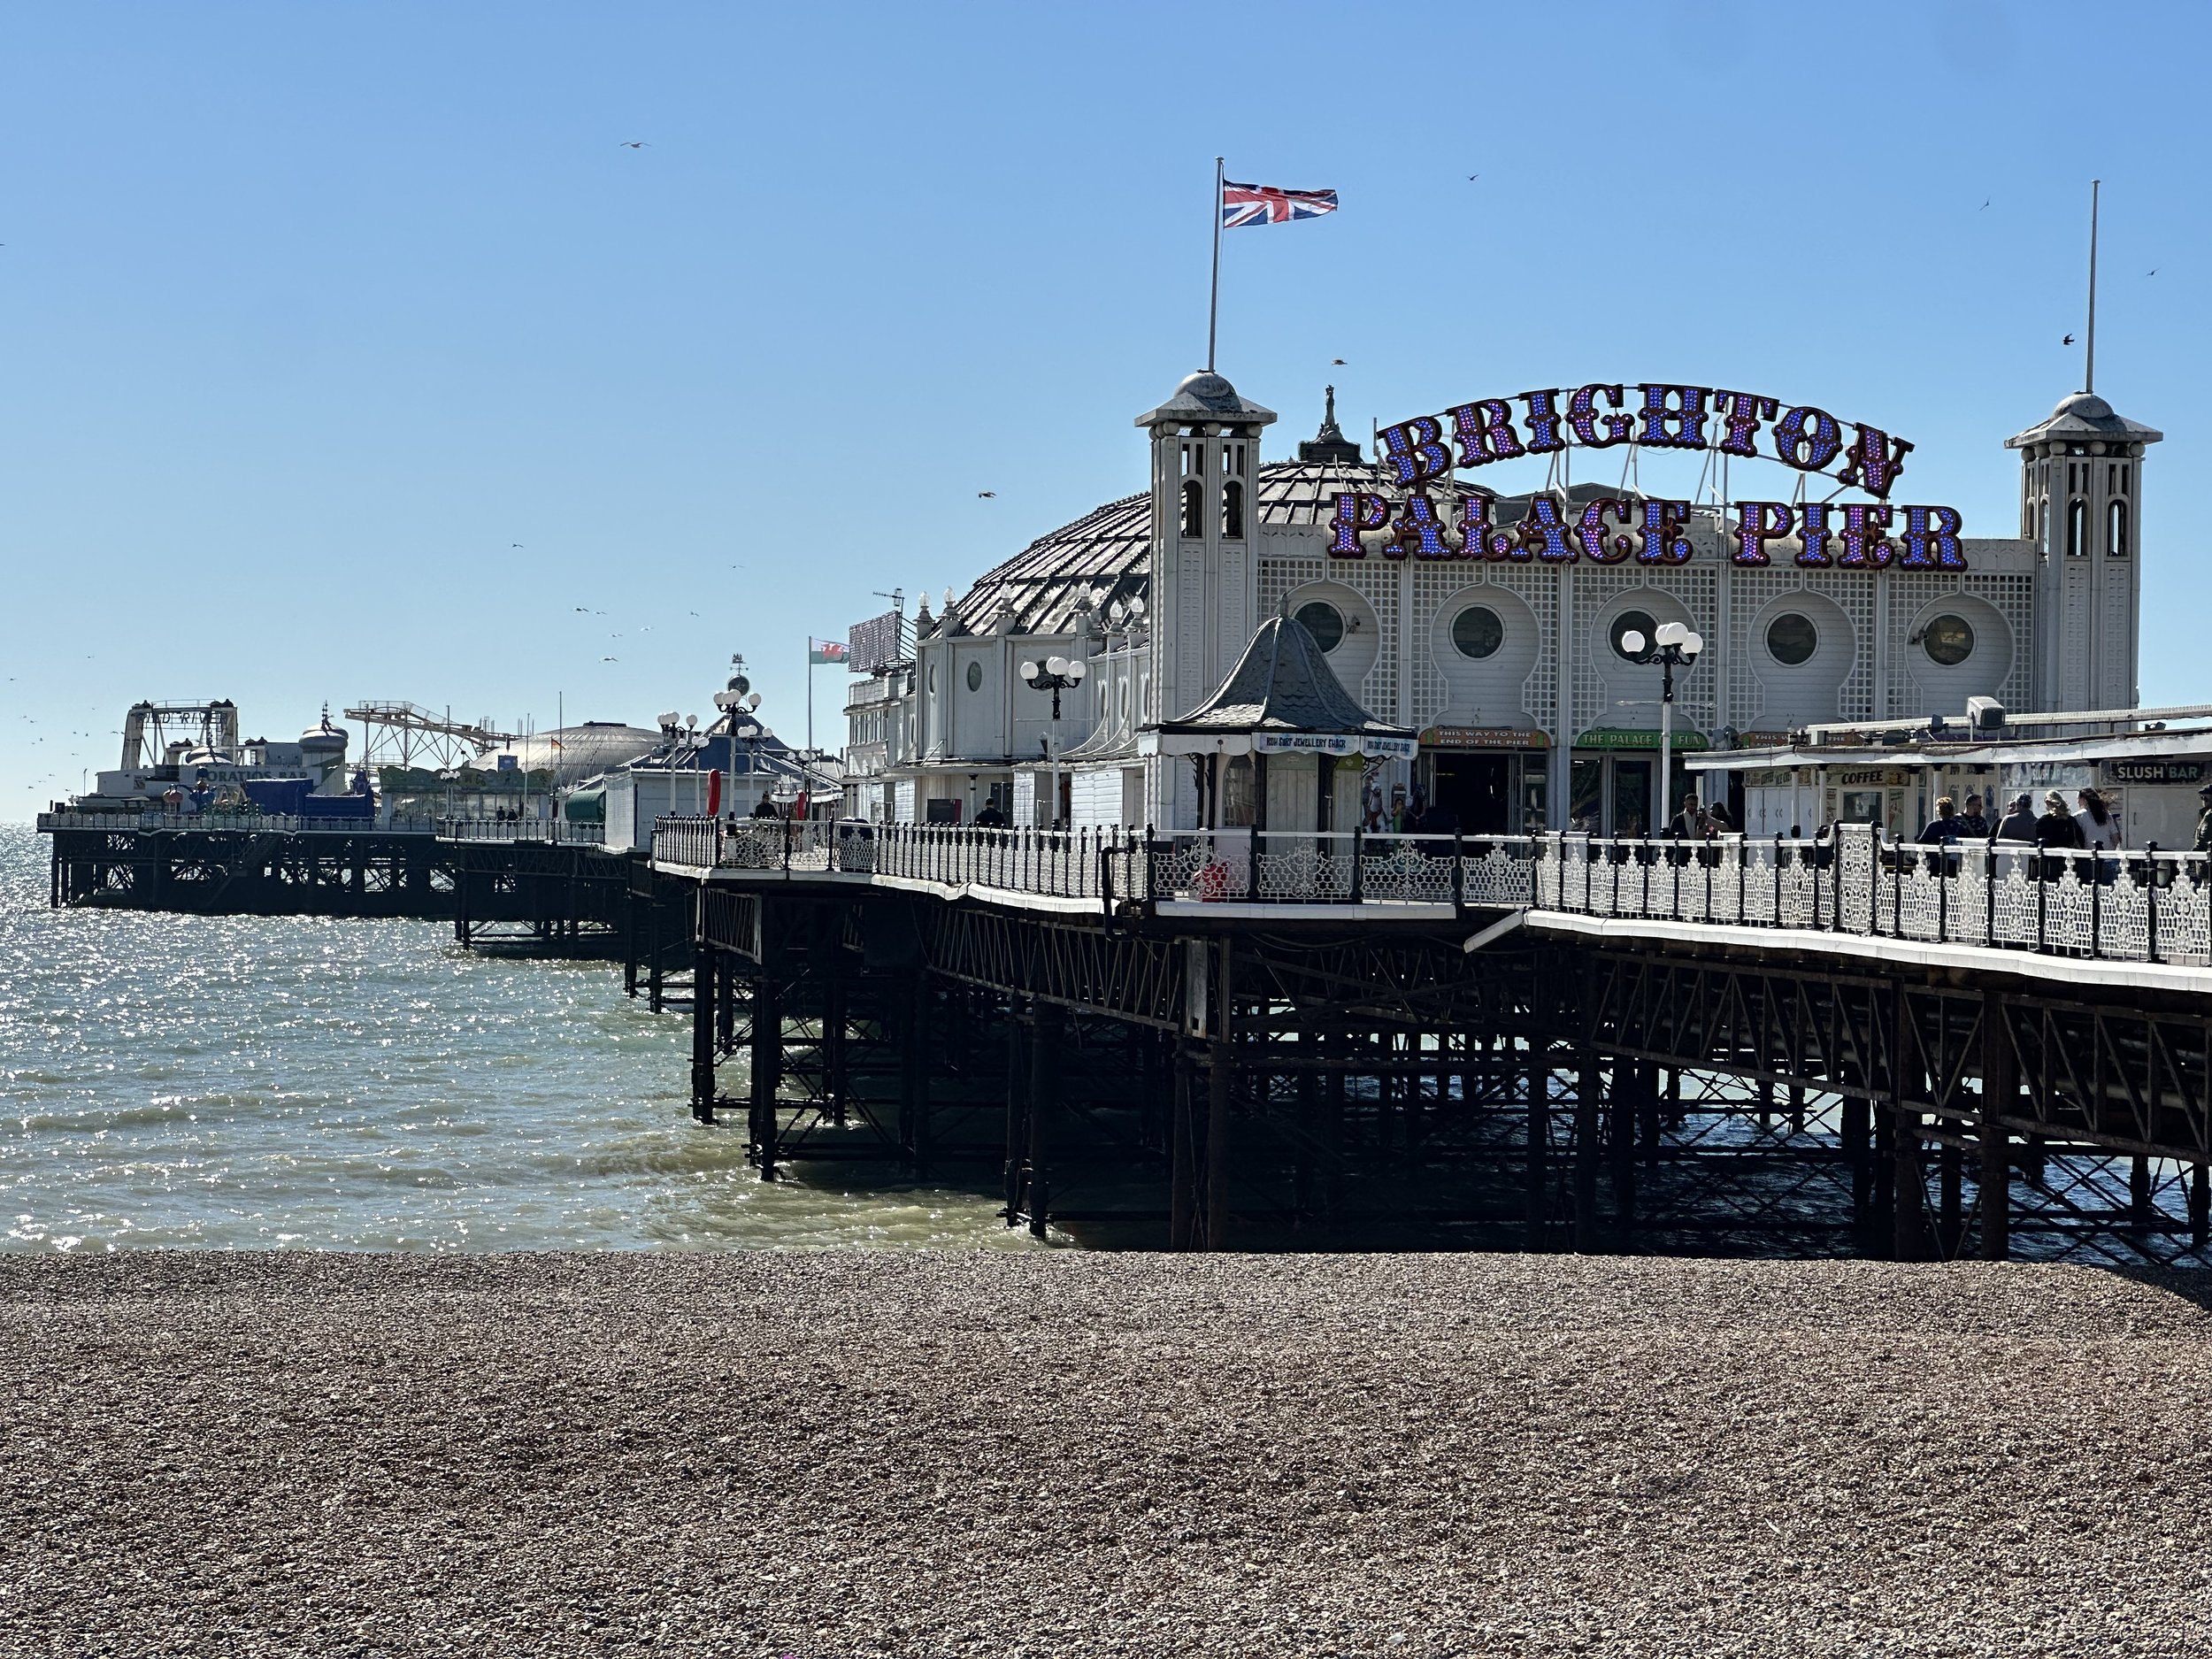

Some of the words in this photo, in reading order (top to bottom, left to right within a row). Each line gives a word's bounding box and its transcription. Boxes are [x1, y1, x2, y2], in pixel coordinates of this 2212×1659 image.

[1377, 383, 1916, 500] BRIGHTON
[1329, 491, 1694, 566] PALACE
[1732, 501, 1969, 572] PIER
[1294, 738, 1327, 748] JEWELLERY
[1328, 738, 1346, 749] SHACK
[1583, 734, 1603, 744] THE
[1610, 734, 1653, 745] PALACE
[1678, 735, 1701, 745] FUN
[196, 771, 272, 782] ORATIOS
[1841, 770, 1884, 785] COFFEE
[2117, 766, 2164, 779] SLUSH
[2169, 766, 2199, 779] BAR
